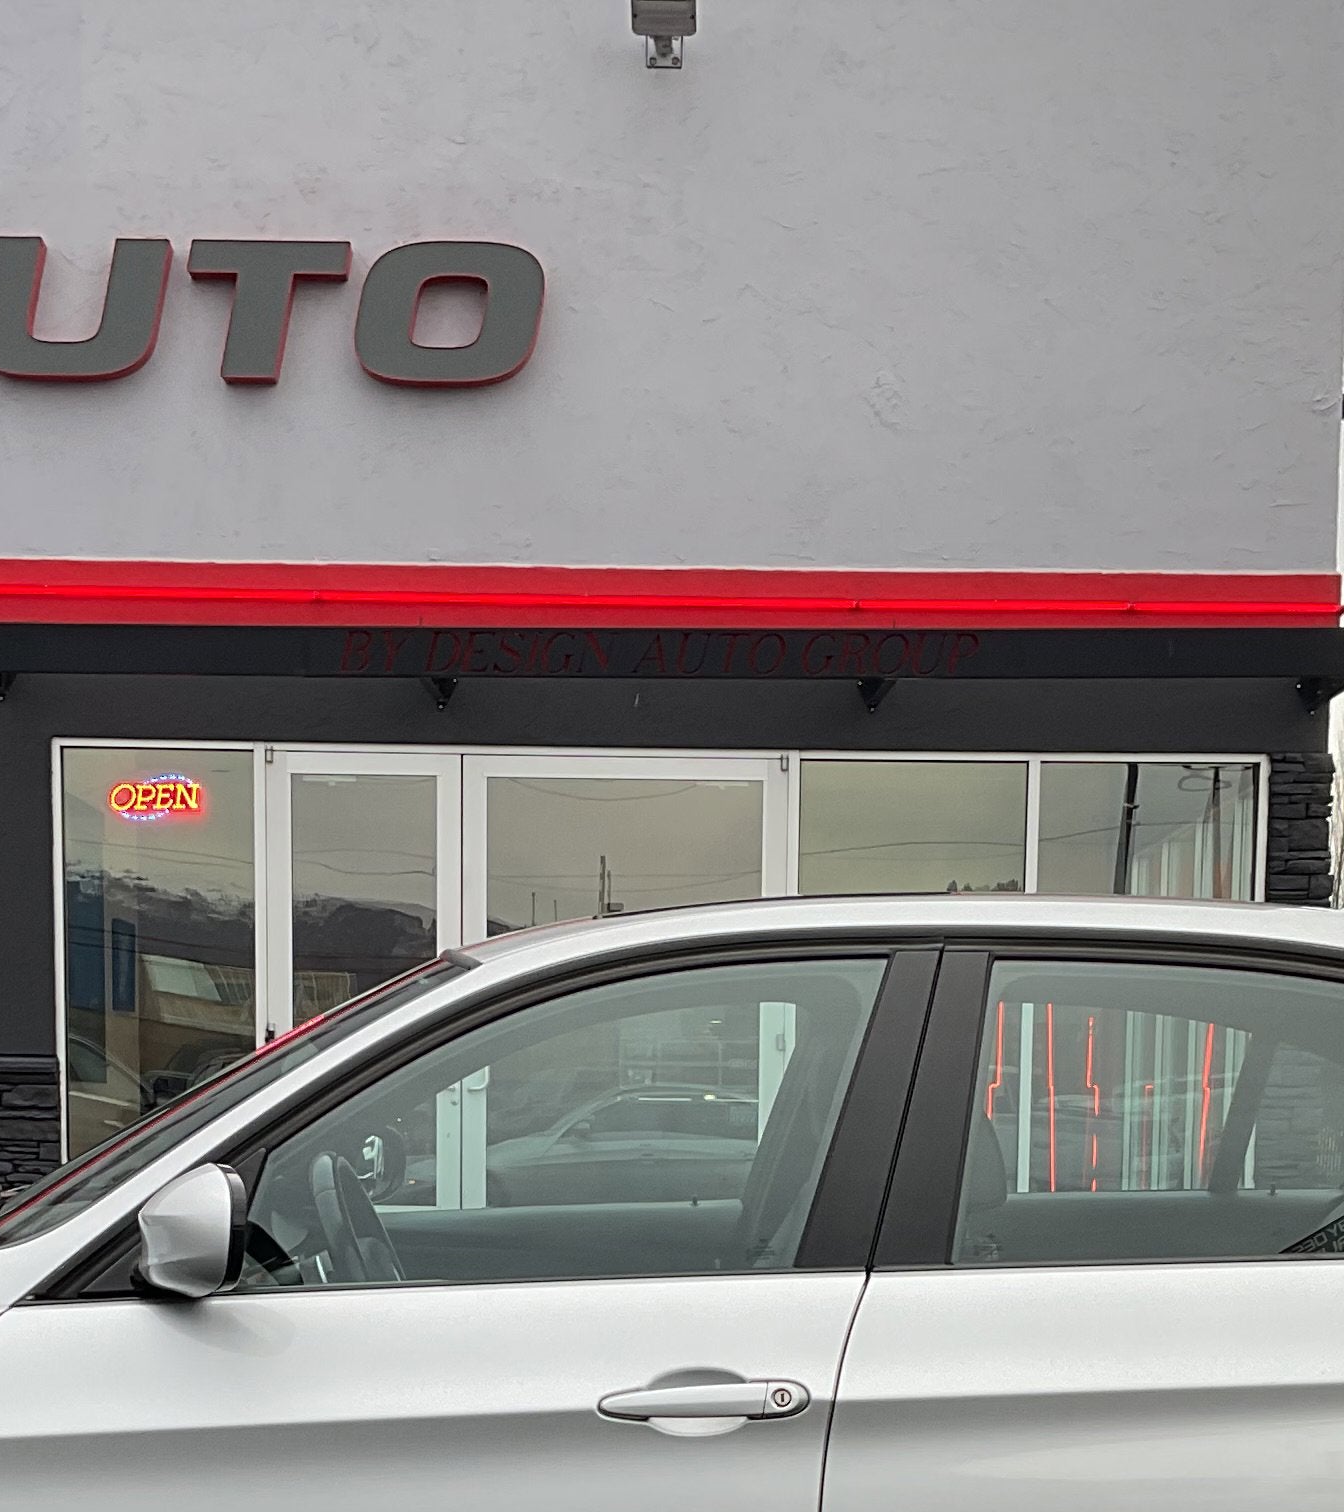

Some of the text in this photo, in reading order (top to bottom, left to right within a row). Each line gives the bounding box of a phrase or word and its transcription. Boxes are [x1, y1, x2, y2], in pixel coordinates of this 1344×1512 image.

[338, 630, 980, 676] BY DESIGN AUTO GROUP
[109, 783, 201, 811] OPEN
